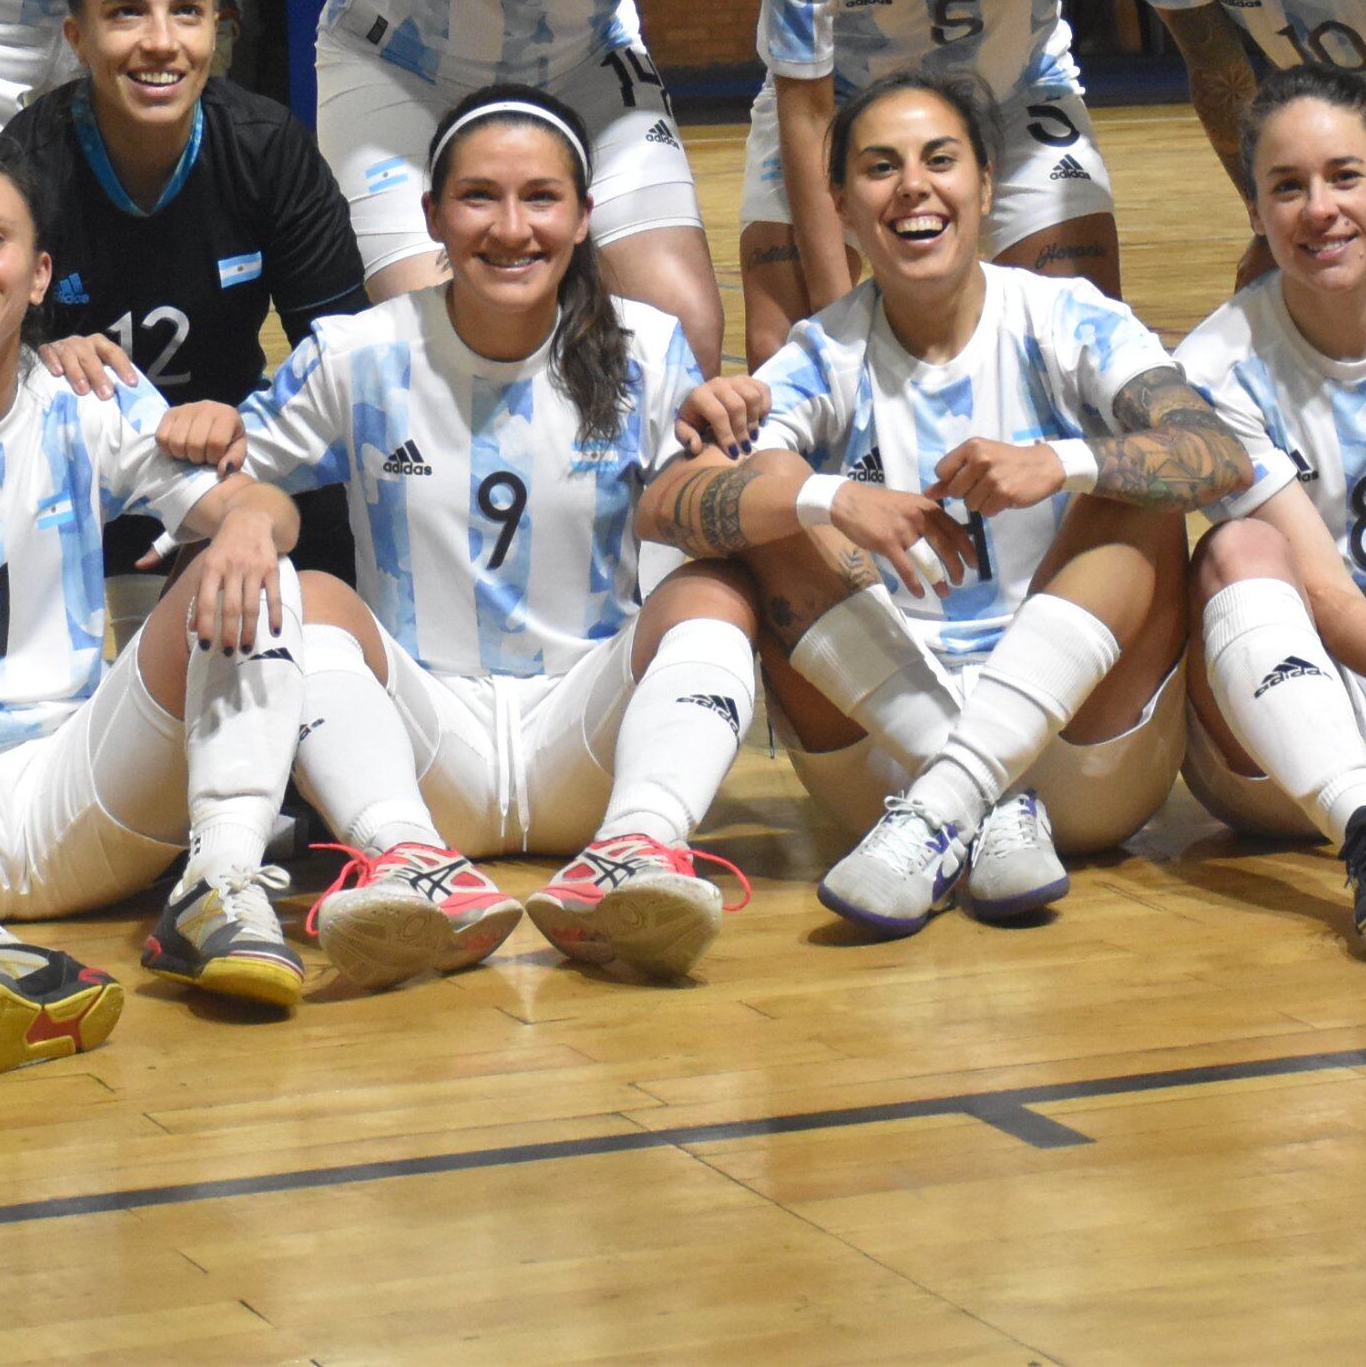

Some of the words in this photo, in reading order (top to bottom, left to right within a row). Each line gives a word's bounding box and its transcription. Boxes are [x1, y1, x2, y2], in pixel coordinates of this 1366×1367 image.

[105, 305, 192, 387] 12
[383, 462, 433, 477] adidas
[477, 470, 529, 570] 9
